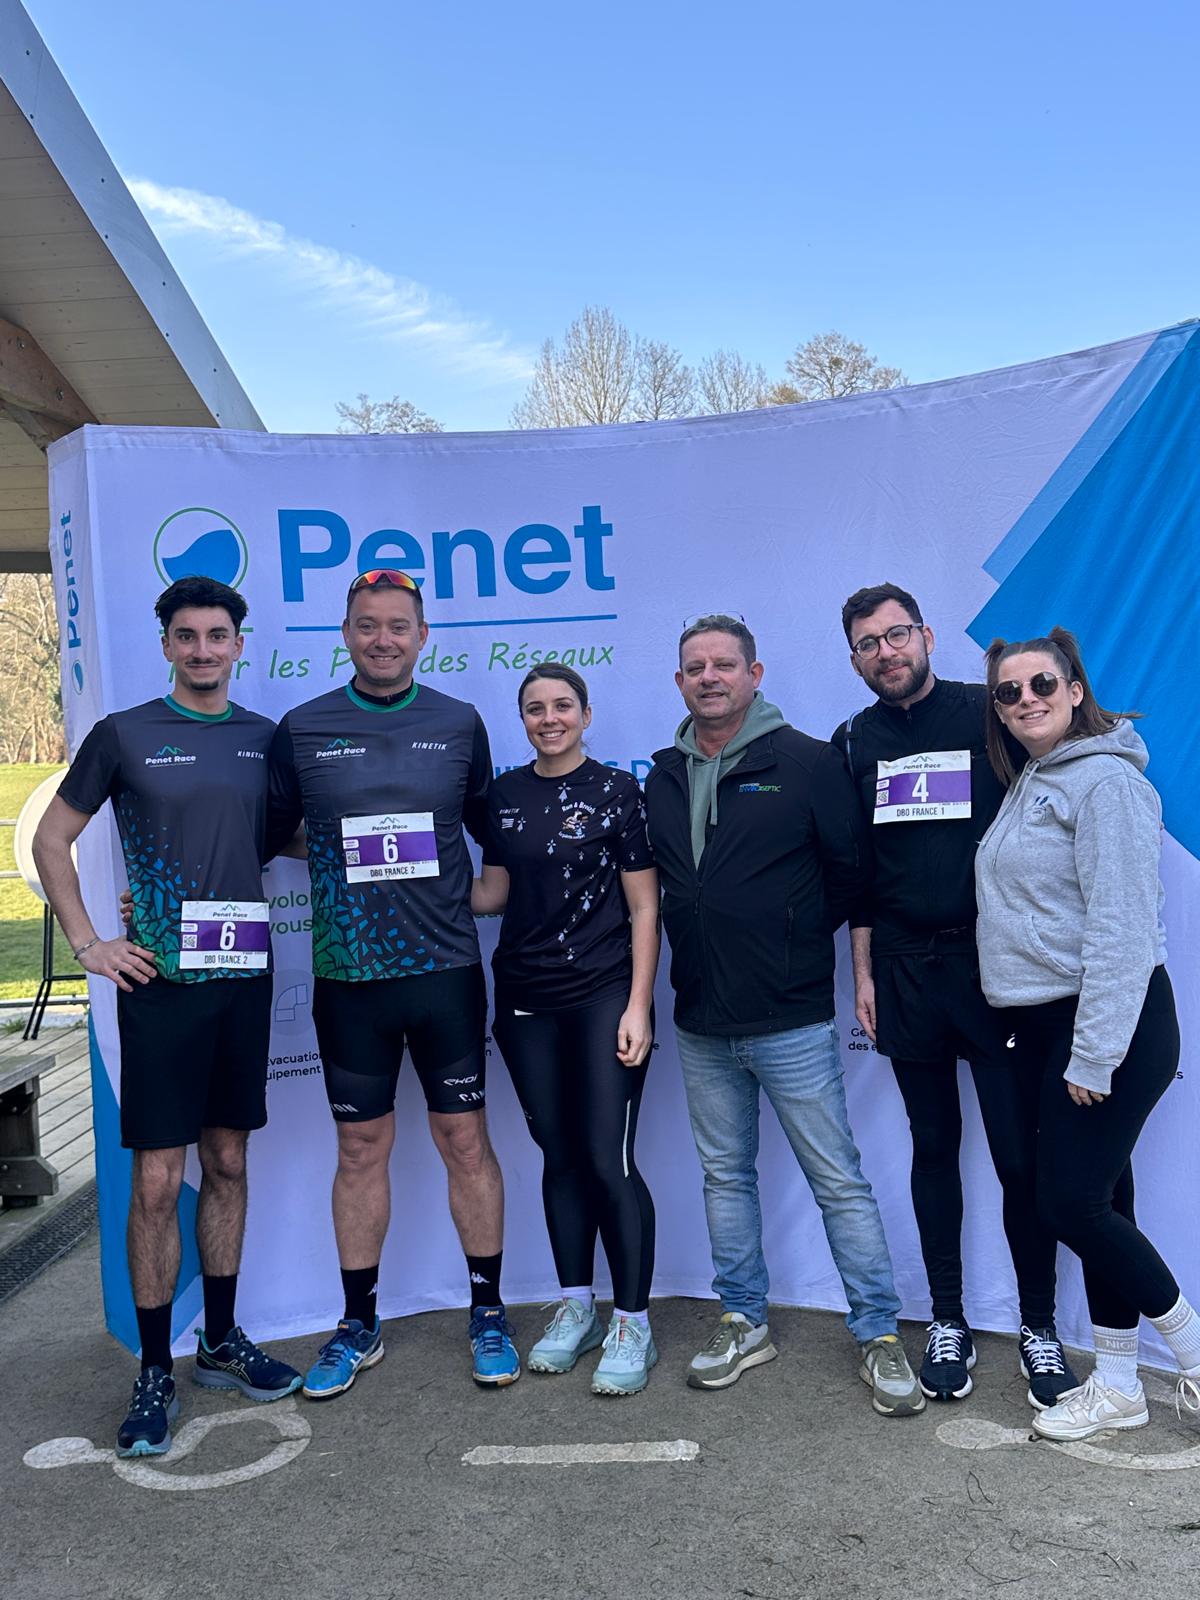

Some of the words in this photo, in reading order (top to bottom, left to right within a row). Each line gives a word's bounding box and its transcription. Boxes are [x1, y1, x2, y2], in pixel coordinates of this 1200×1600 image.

[278, 505, 616, 602] Penet
[60, 510, 82, 648] Penet
[269, 649, 310, 679] les
[419, 644, 468, 673] des
[488, 642, 614, 671] Réseaux
[316, 748, 342, 758] Penet
[343, 747, 366, 755] Race
[411, 741, 447, 751] KINETIK
[145, 756, 172, 765] Penet
[174, 755, 197, 763] Race
[911, 772, 929, 803] 4
[896, 808, 910, 817] DBO
[912, 807, 938, 816] FRANCE
[941, 807, 945, 815] 1
[382, 833, 399, 864] 6
[384, 867, 408, 877] FRANCE
[410, 866, 416, 874] 2
[219, 921, 236, 951] 6
[217, 954, 242, 965] FRANCE
[243, 955, 249, 965] 2
[848, 1041, 869, 1051] des
[266, 1051, 319, 1067] vacuatio
[266, 1065, 321, 1081] uipement
